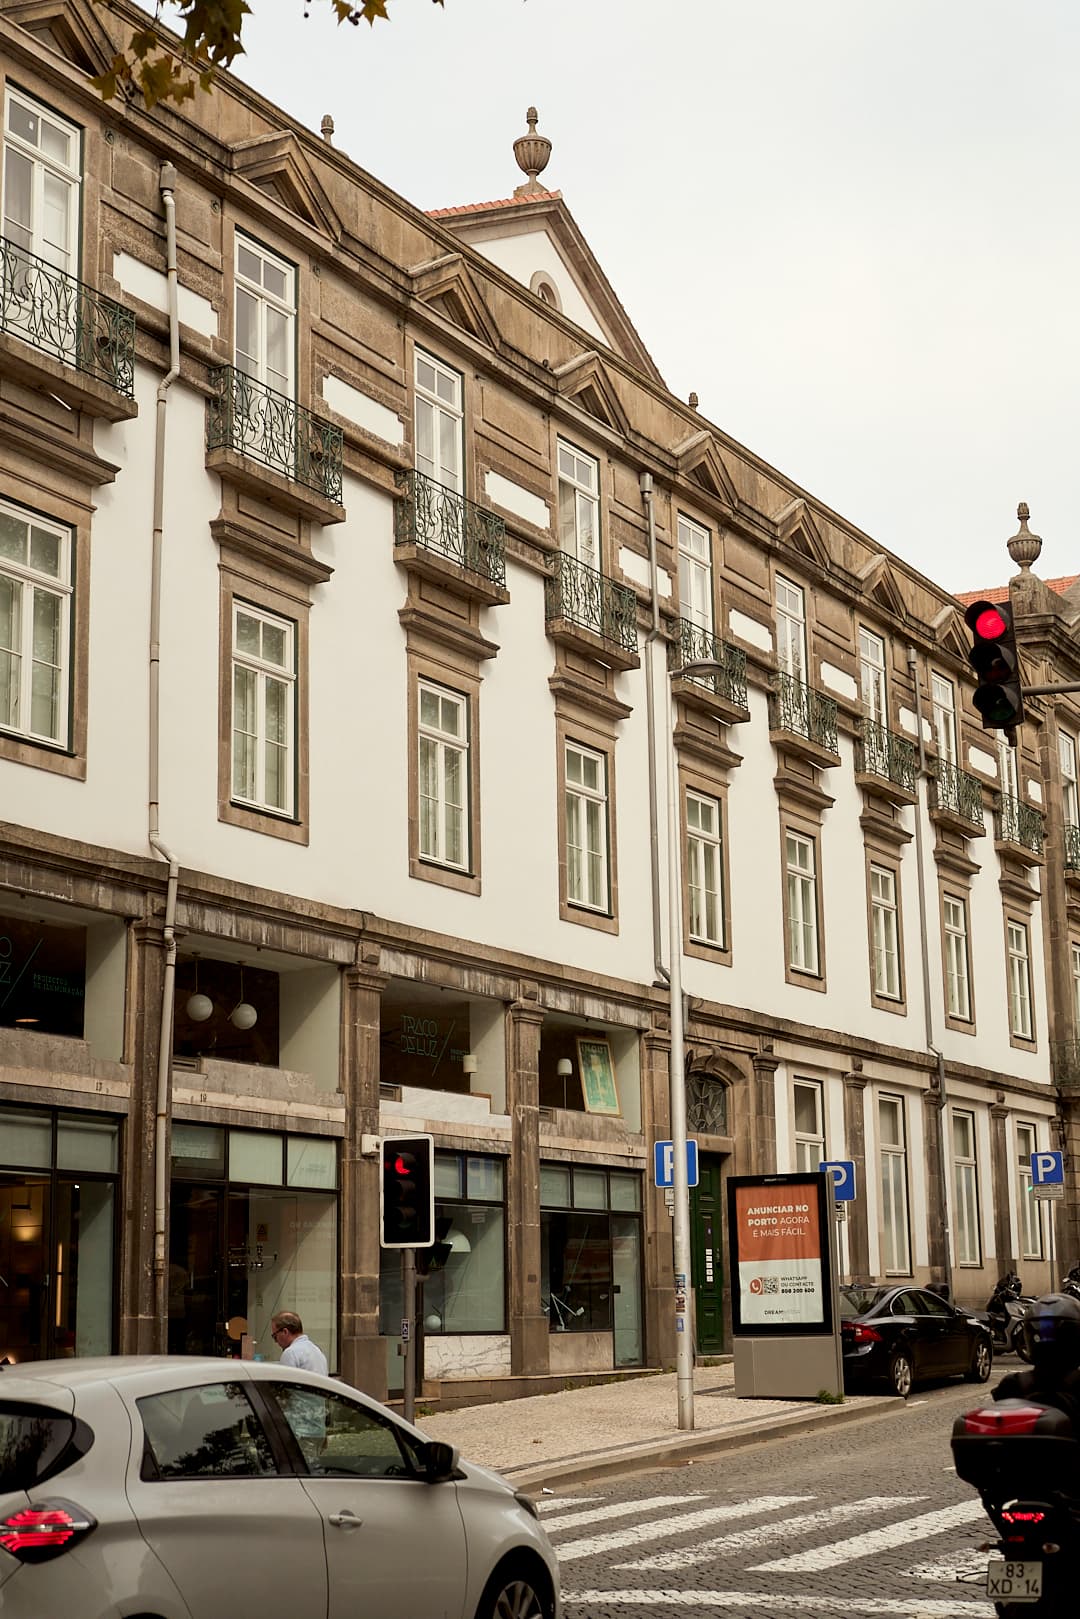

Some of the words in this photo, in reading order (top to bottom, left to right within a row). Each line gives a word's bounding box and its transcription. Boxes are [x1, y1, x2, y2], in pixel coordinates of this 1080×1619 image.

[1037, 1154, 1056, 1182] P
[747, 1205, 794, 1215] ANUNCIAR
[795, 1204, 809, 1213] NO
[748, 1217, 778, 1227] PORTO
[779, 1215, 810, 1225] AGORA
[760, 1228, 780, 1237] MAIS
[1006, 1563, 1025, 1578] 83
